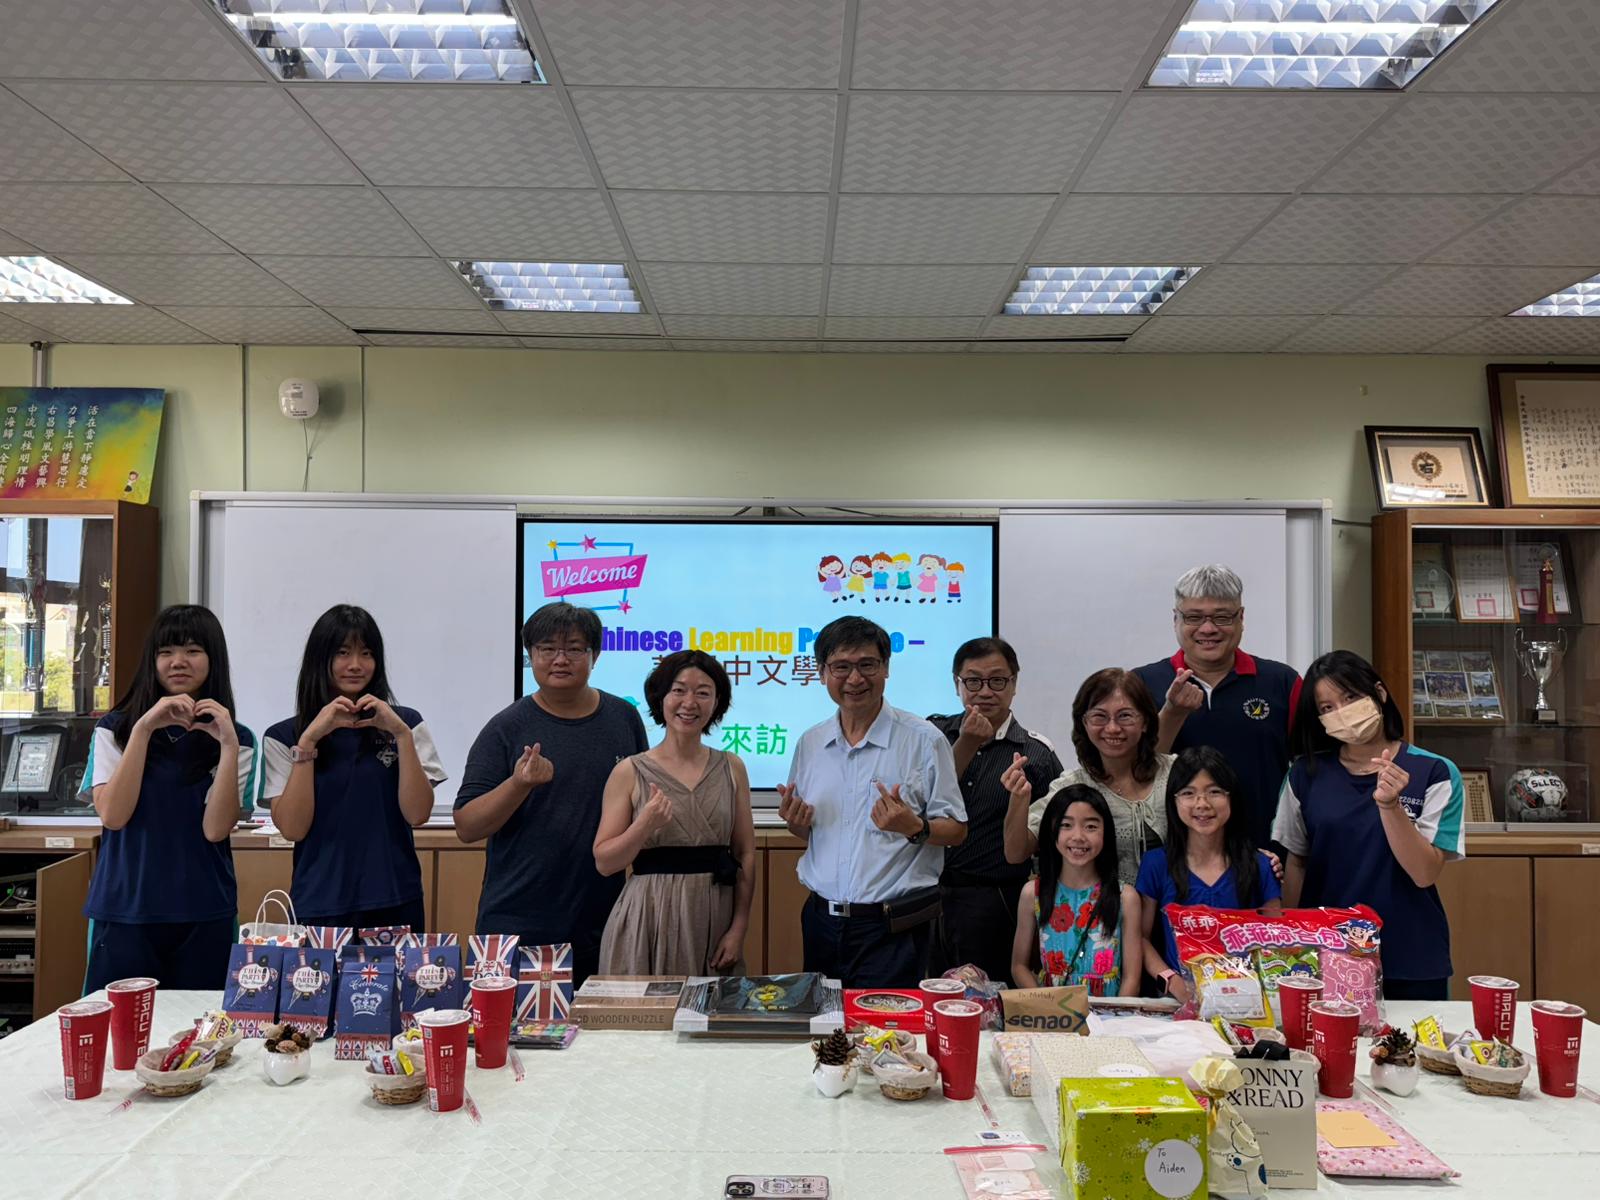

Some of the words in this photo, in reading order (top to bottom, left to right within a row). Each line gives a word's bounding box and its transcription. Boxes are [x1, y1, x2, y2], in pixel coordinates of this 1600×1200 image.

[547, 564, 638, 589] Welcome
[602, 627, 683, 651] hinese
[689, 627, 793, 654] Learning
[721, 723, 787, 755] 來訪
[1182, 915, 1217, 933] 乖乖
[1221, 923, 1347, 953] 乖乖綜合包
[590, 1015, 630, 1024] WOODEN
[632, 1015, 664, 1024] PUZZLE
[1008, 1014, 1072, 1030] senao
[1241, 1067, 1303, 1088] ONNY
[1157, 1147, 1167, 1158] To
[1158, 1161, 1186, 1174] Aiden
